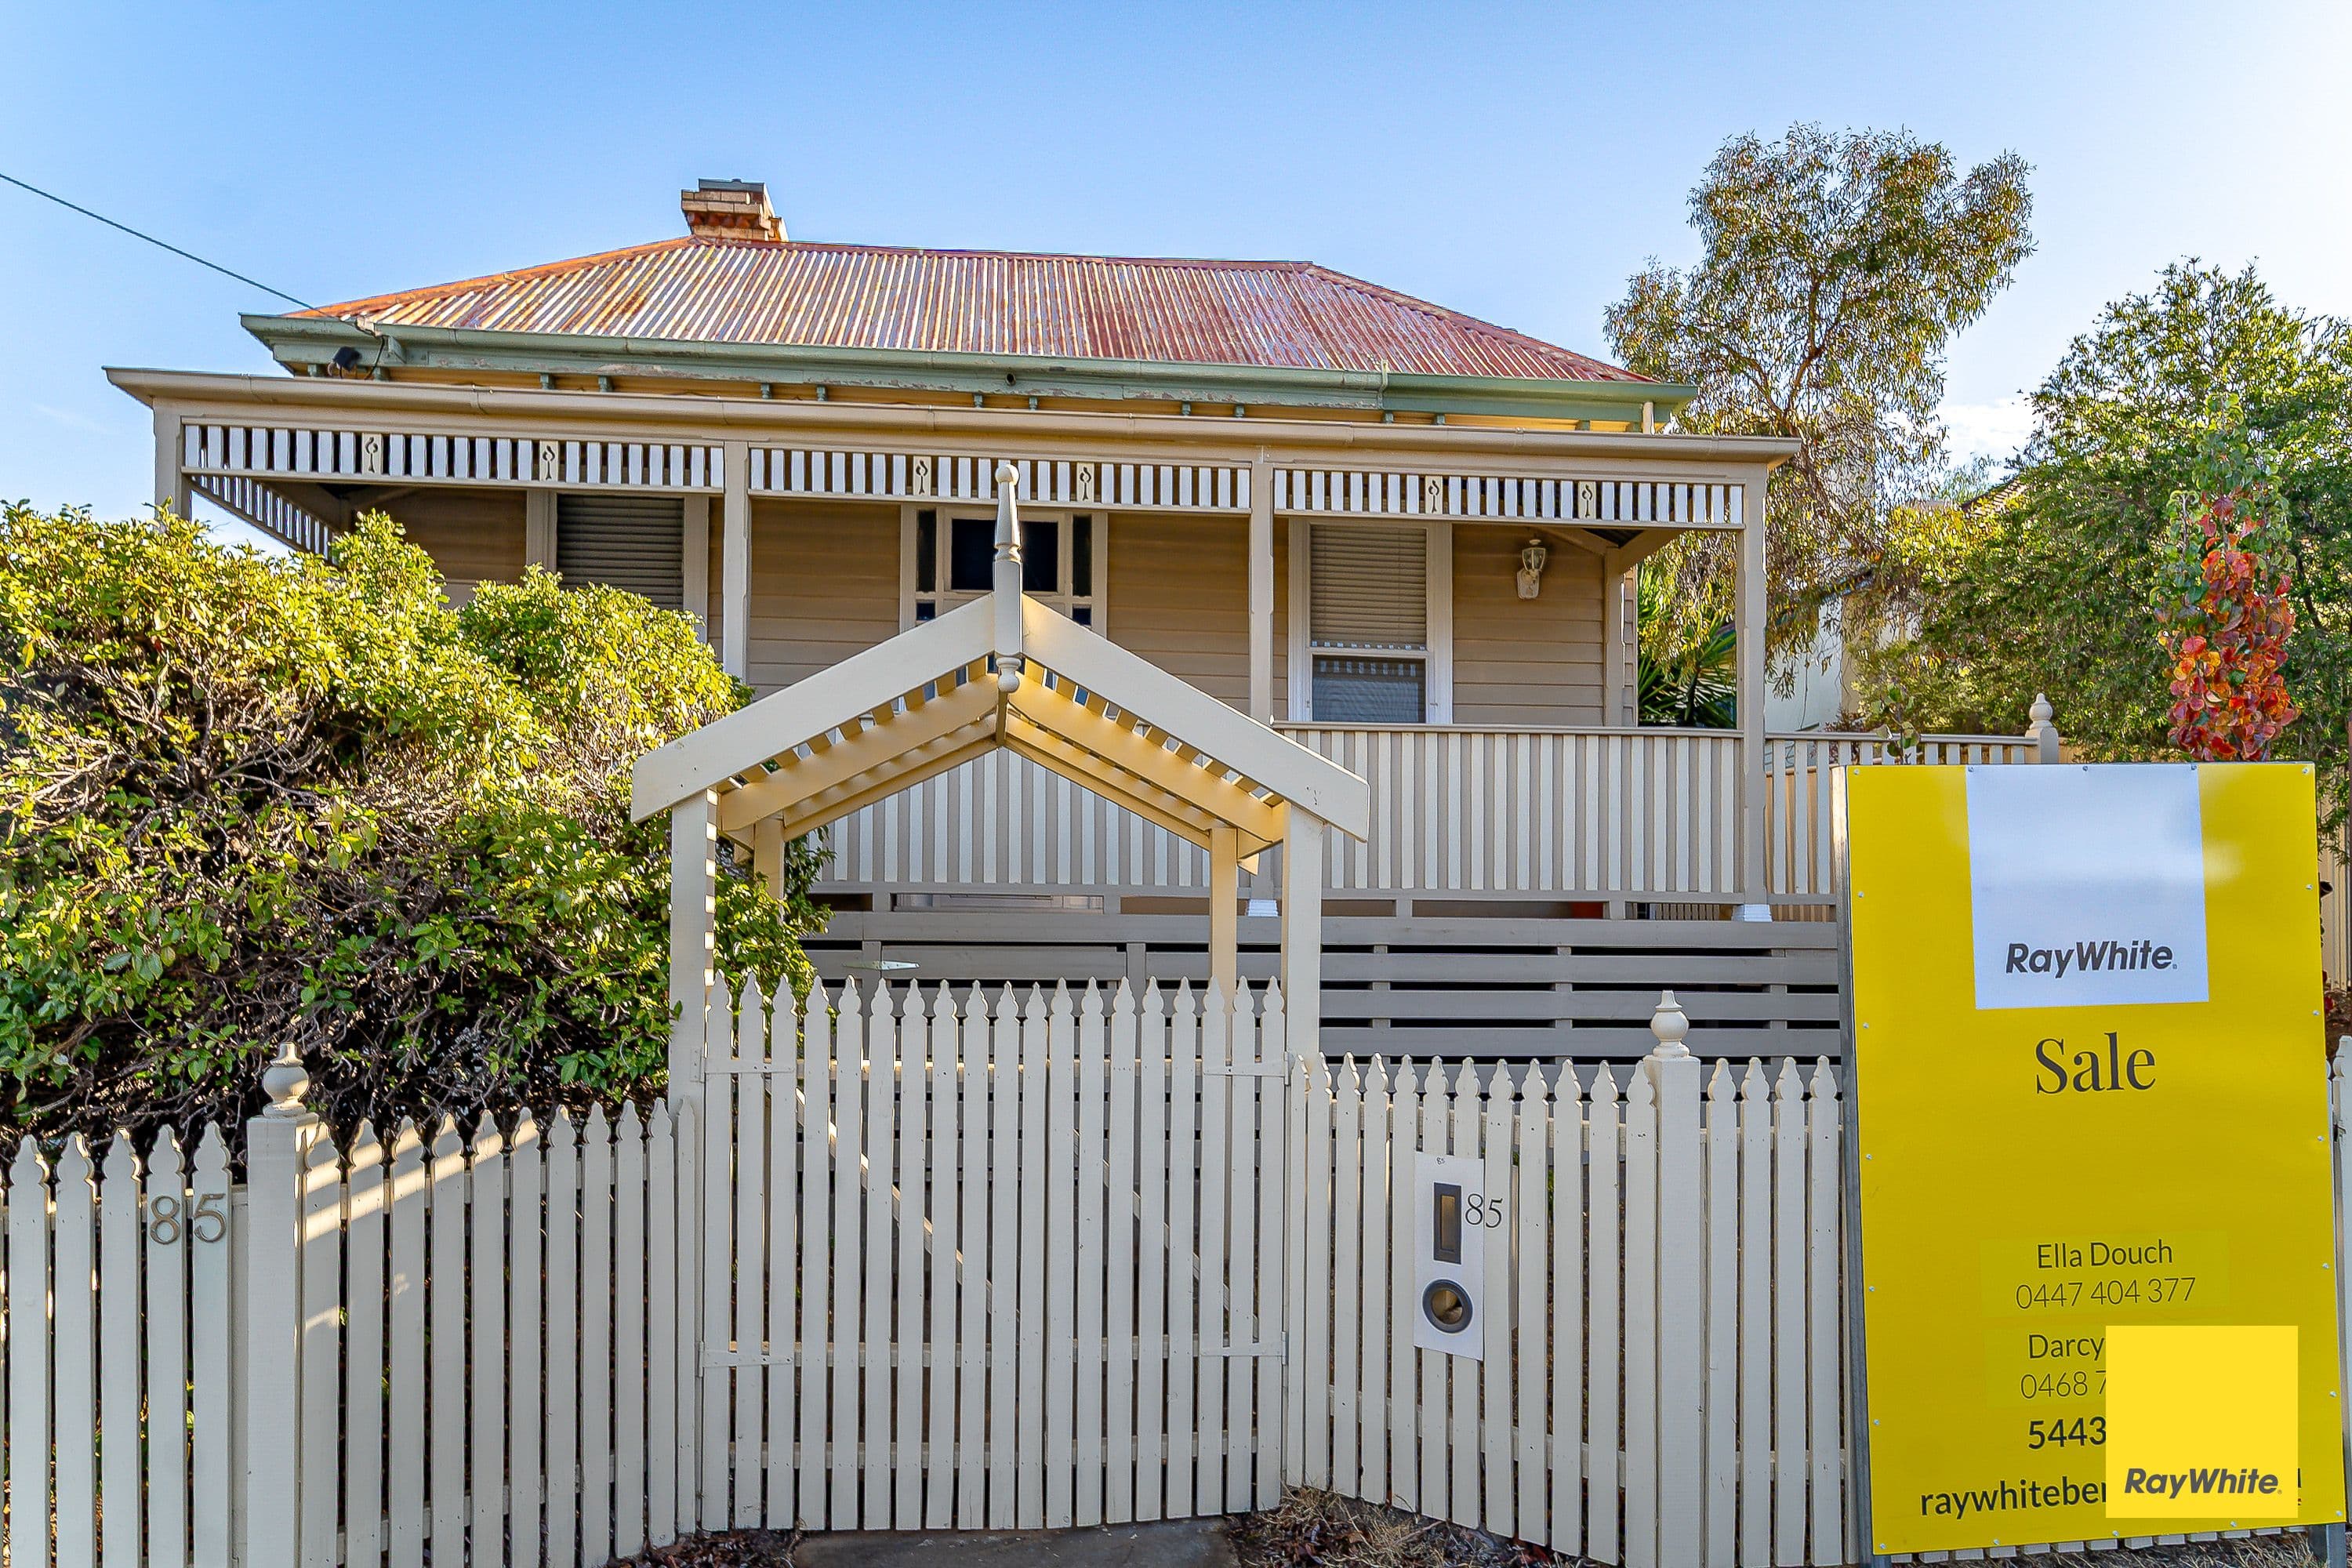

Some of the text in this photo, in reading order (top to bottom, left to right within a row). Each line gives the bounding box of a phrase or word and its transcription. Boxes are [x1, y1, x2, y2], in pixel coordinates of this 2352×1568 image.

[2035, 1032, 2156, 1094] Sale
[150, 1193, 226, 1245] 85
[1465, 1193, 1503, 1229] 85
[2038, 1239, 2172, 1269] Ella Douch
[2016, 1277, 2196, 1309] 0447 404 377
[2029, 1334, 2105, 1361] Darcy
[2020, 1371, 2088, 1399] 0468
[2028, 1416, 2107, 1450] 5443
